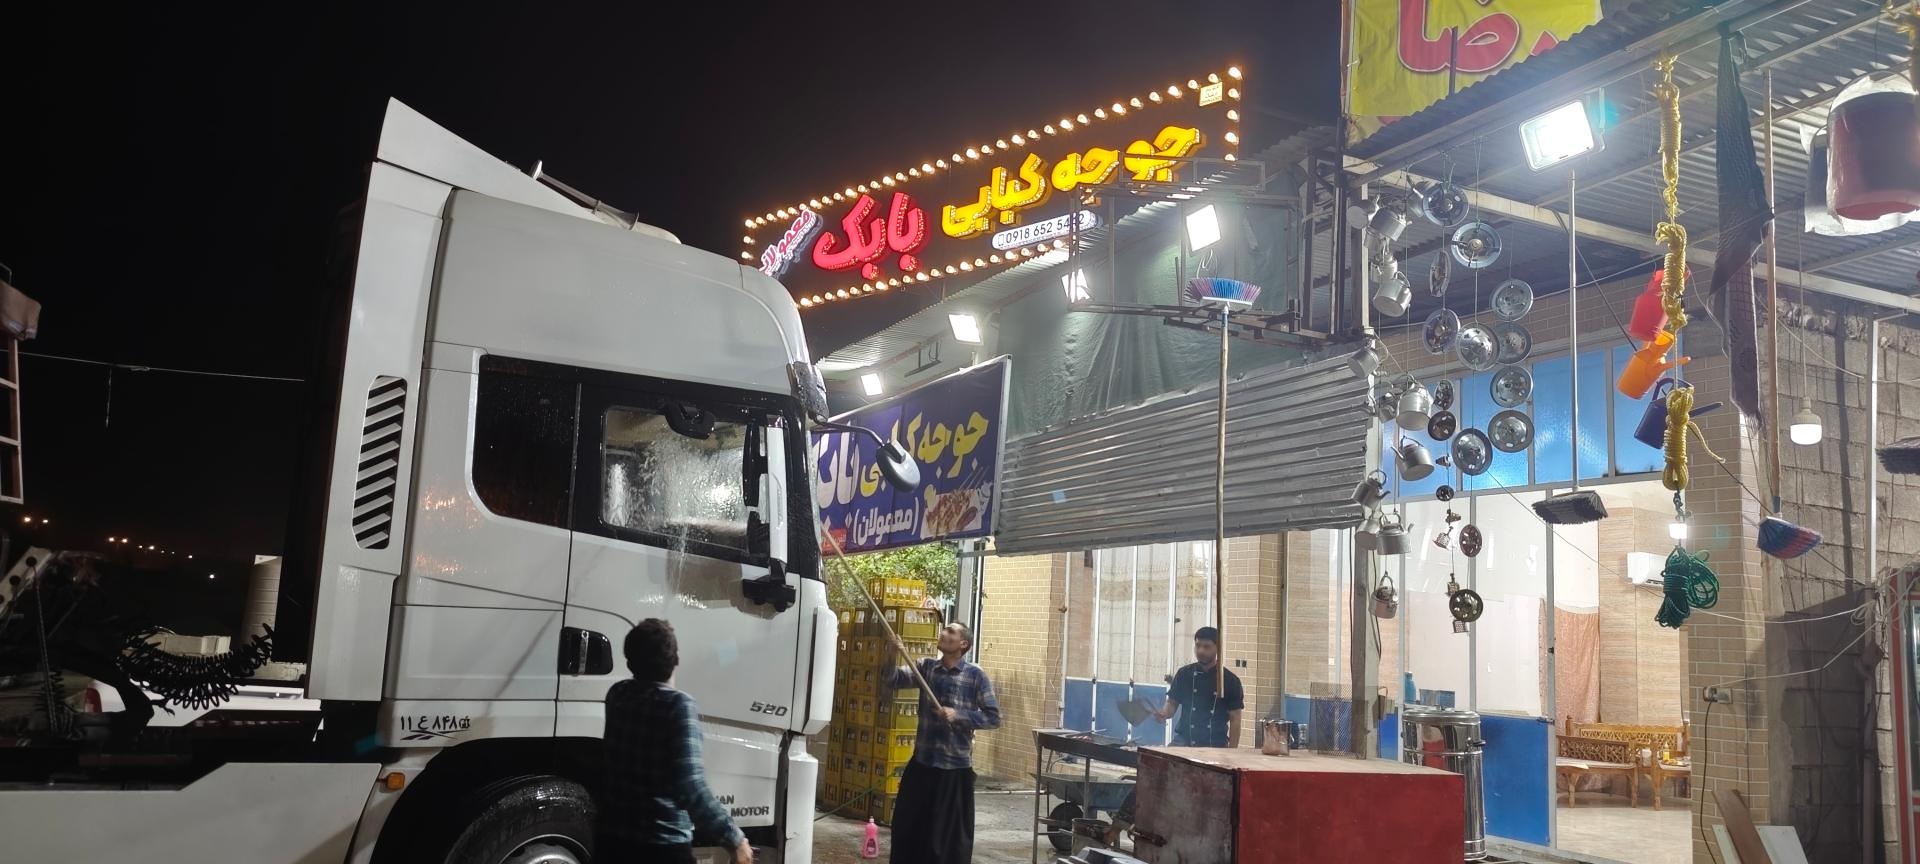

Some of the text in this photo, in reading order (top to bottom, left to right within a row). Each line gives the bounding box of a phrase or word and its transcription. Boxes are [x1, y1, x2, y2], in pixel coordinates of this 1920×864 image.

[812, 126, 1202, 280] جوجه کبابی بابک
[1005, 213, 1085, 243] 0918 652 542
[917, 411, 990, 479] جوجه
[749, 701, 788, 717] 520
[715, 795, 735, 805] AN
[730, 806, 770, 817] MOTOR
